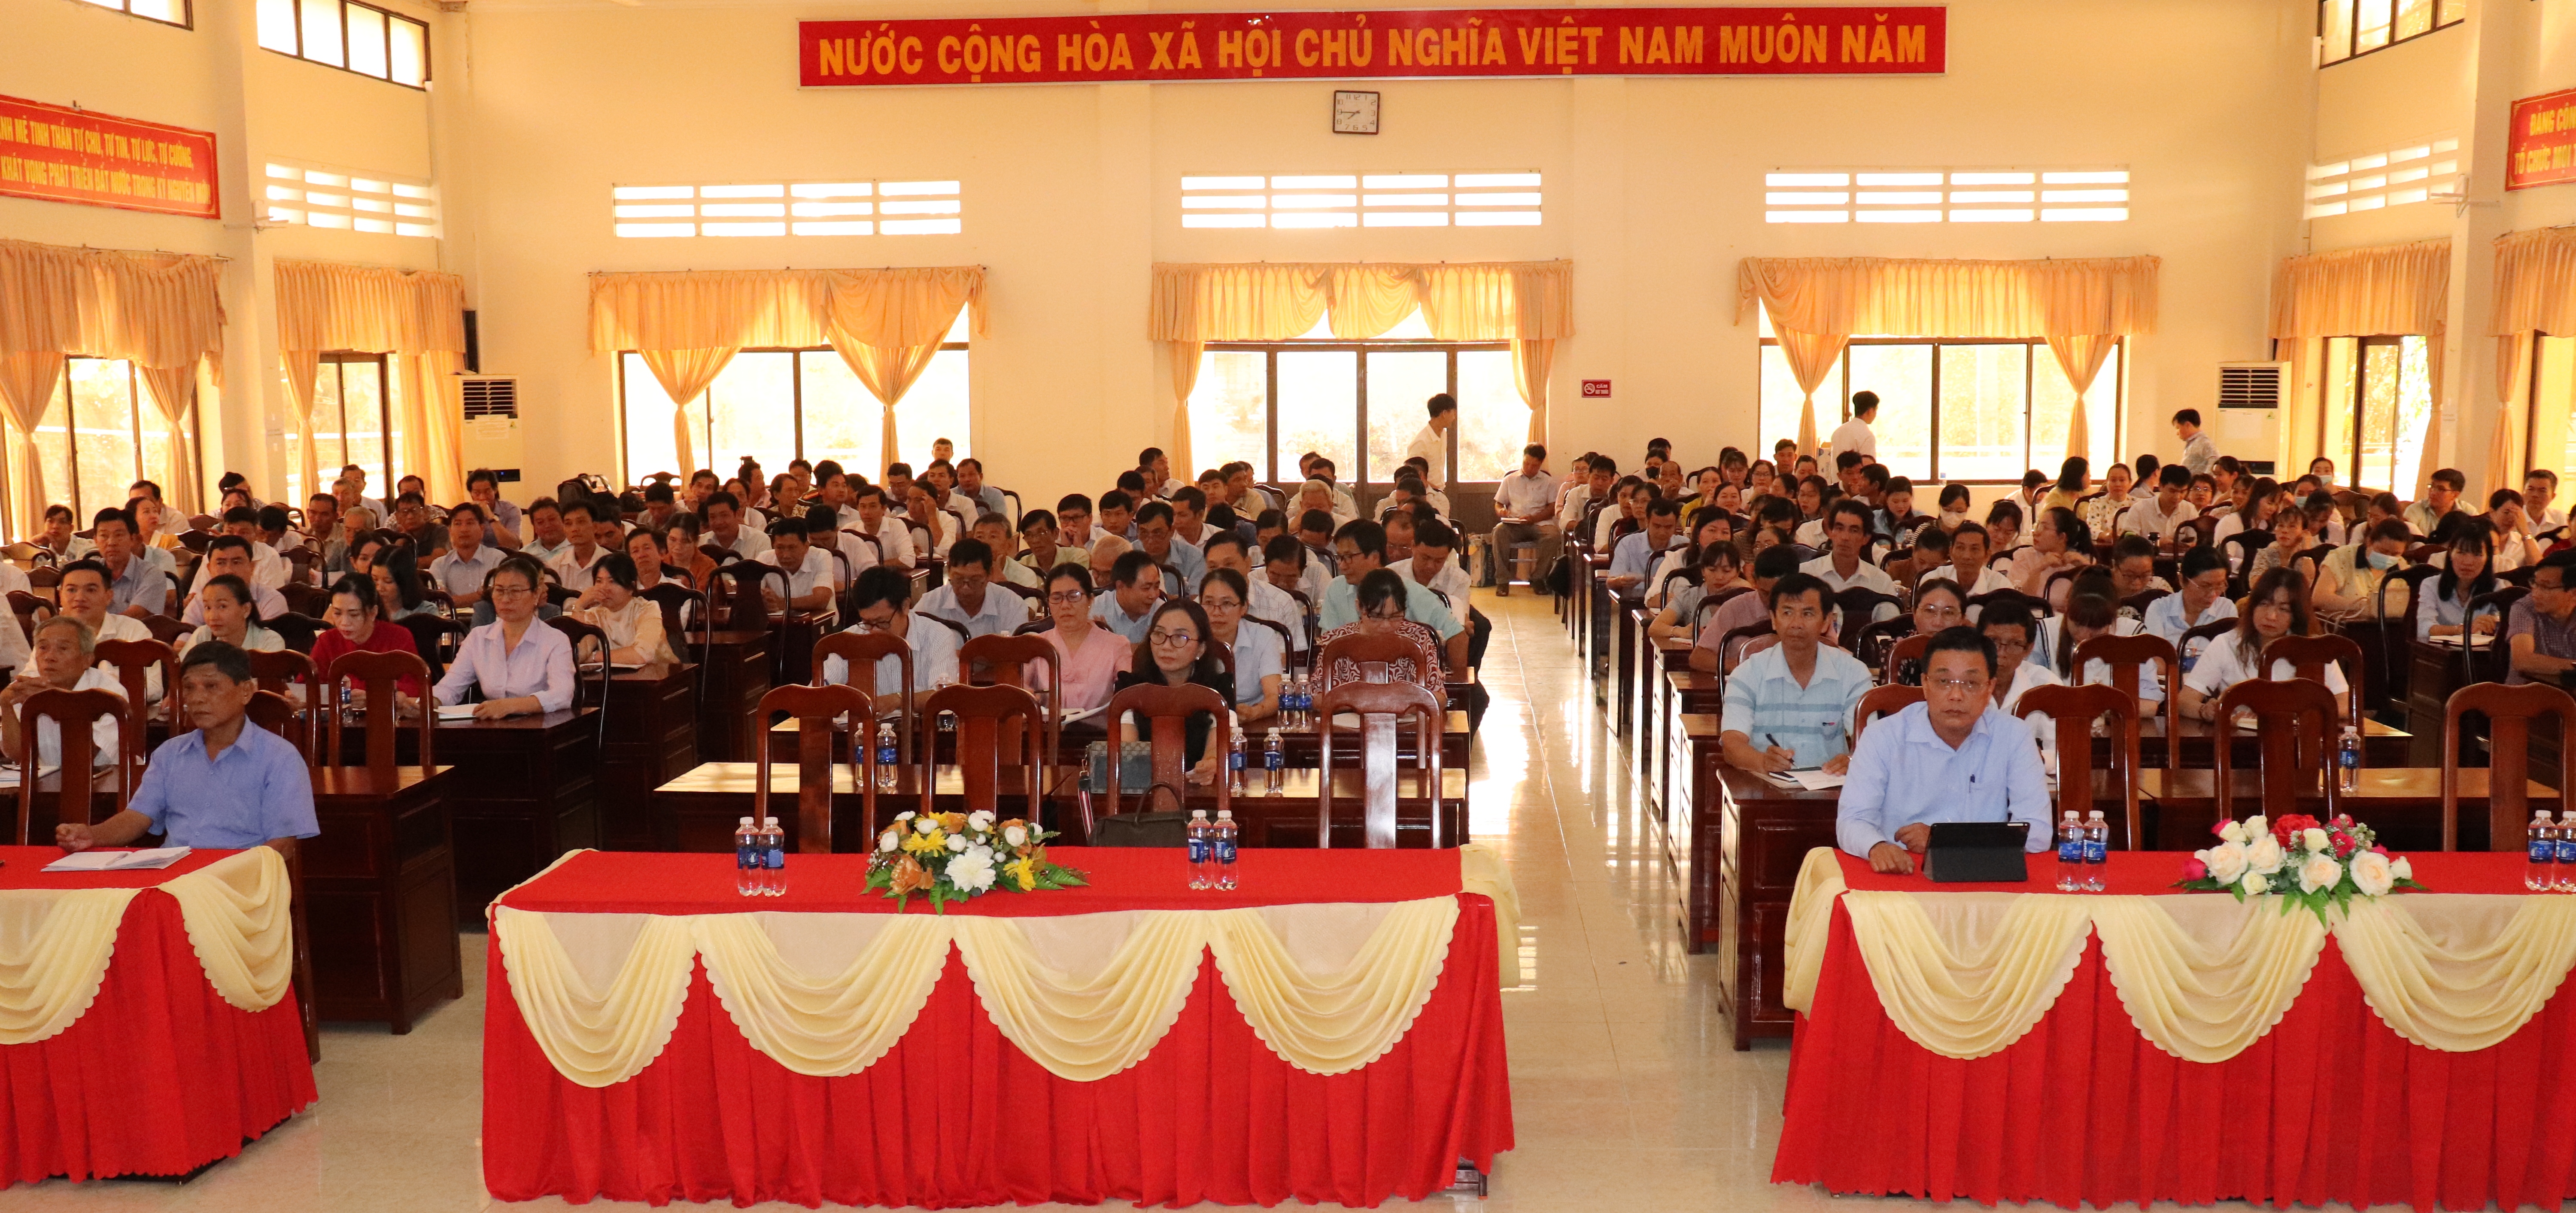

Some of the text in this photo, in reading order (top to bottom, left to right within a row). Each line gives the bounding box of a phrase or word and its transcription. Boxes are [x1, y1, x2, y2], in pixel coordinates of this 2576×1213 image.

[820, 13, 1926, 82] NƯỚC CỘNG HÒA XÃ HỘI CHỦ NGHĨA VIỆT NAM MUÔN NĂM
[29, 121, 50, 147] TINH
[50, 118, 73, 150] THẦN
[73, 127, 84, 158] TỰ
[85, 125, 103, 158] CHỦ,
[104, 132, 114, 161] TỰ
[131, 137, 141, 166] TỰ
[158, 142, 167, 169] TỰ
[2530, 105, 2555, 136] ĐẢNG
[1, 152, 22, 182] KHÁT
[24, 159, 48, 189] VỌNG
[48, 159, 69, 188] PHÁT
[70, 158, 94, 191] TRIỂN
[110, 168, 131, 196] NƯỚC
[132, 174, 156, 199] TRONG
[167, 177, 195, 203] NGUYÊN
[2527, 144, 2552, 173] CHỨC
